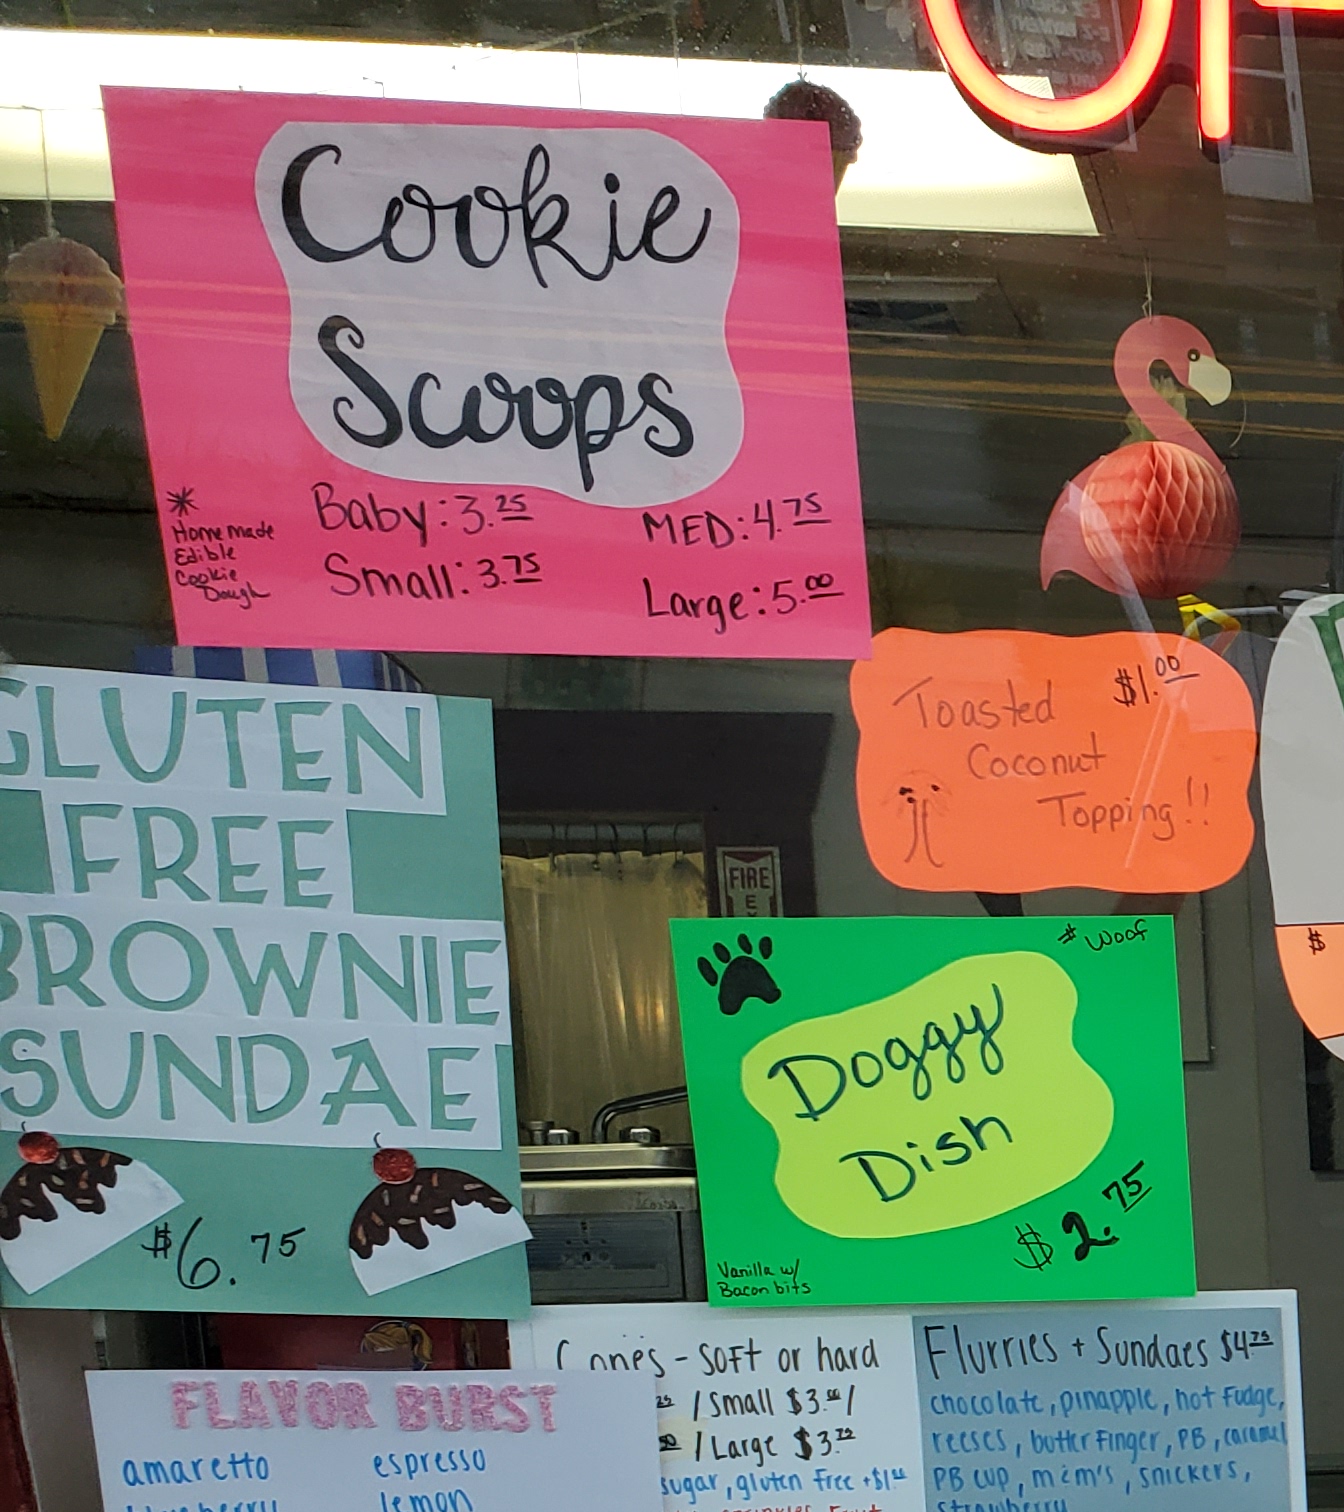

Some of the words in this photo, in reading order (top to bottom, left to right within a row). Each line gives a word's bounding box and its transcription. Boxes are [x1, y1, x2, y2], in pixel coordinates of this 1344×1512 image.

[281, 142, 712, 290] Cookie
[316, 314, 695, 492] Scoops
[174, 547, 236, 566] Edible
[201, 584, 271, 609] Dough
[893, 676, 1056, 729] Toasted
[967, 732, 1107, 780] Coconut
[62, 803, 335, 908] FREE
[729, 865, 770, 891] FIRE
[768, 982, 1004, 1122] Doggy
[0, 1029, 495, 1131] SUNDAE
[840, 1115, 1013, 1202] Dish
[717, 1261, 774, 1278] Vanilla
[924, 1325, 1058, 1380] Flurries
[1097, 1326, 1208, 1369] Sundaes
[170, 1380, 378, 1430] FLAVOR
[395, 1383, 559, 1432] BURST
[123, 1452, 270, 1488] amaretto
[373, 1448, 487, 1478] espresso
